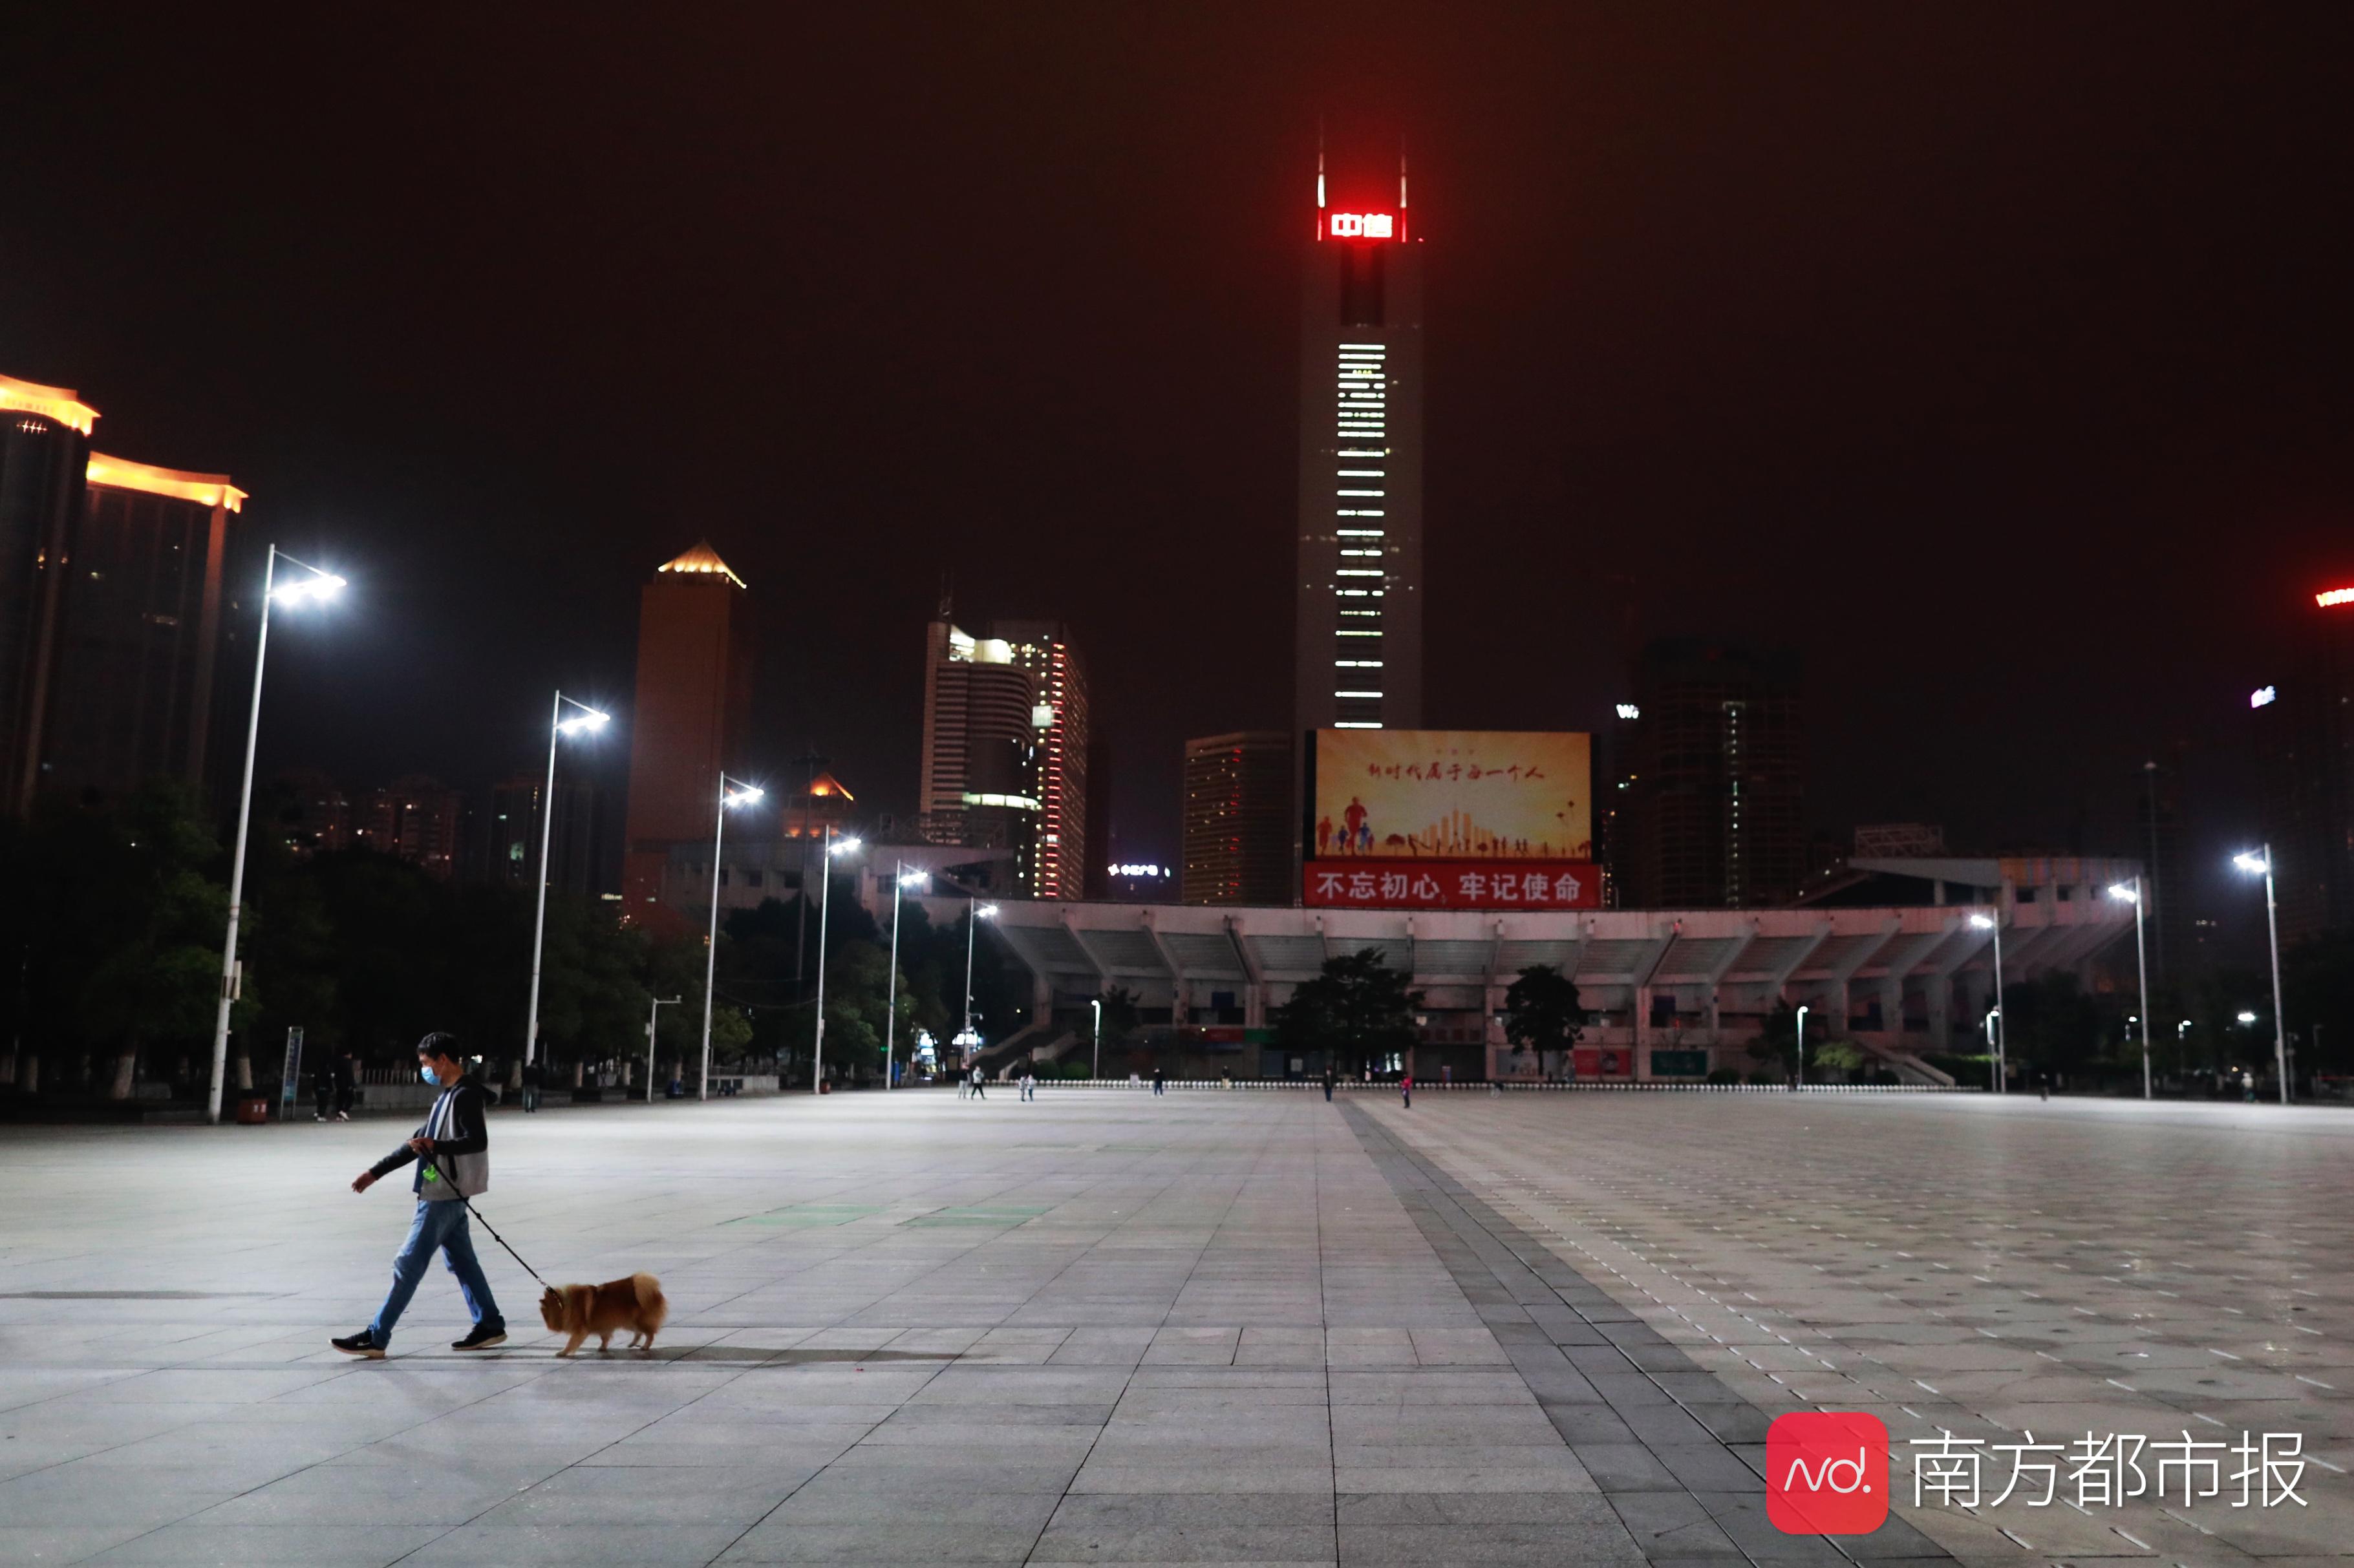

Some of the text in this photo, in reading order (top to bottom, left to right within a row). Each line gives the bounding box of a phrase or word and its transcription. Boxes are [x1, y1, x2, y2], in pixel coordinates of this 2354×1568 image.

[1331, 213, 1393, 238] 中信
[1368, 761, 1545, 781] 新时代属于每一个人
[1317, 871, 1581, 902] 不忘初心 牢记使命
